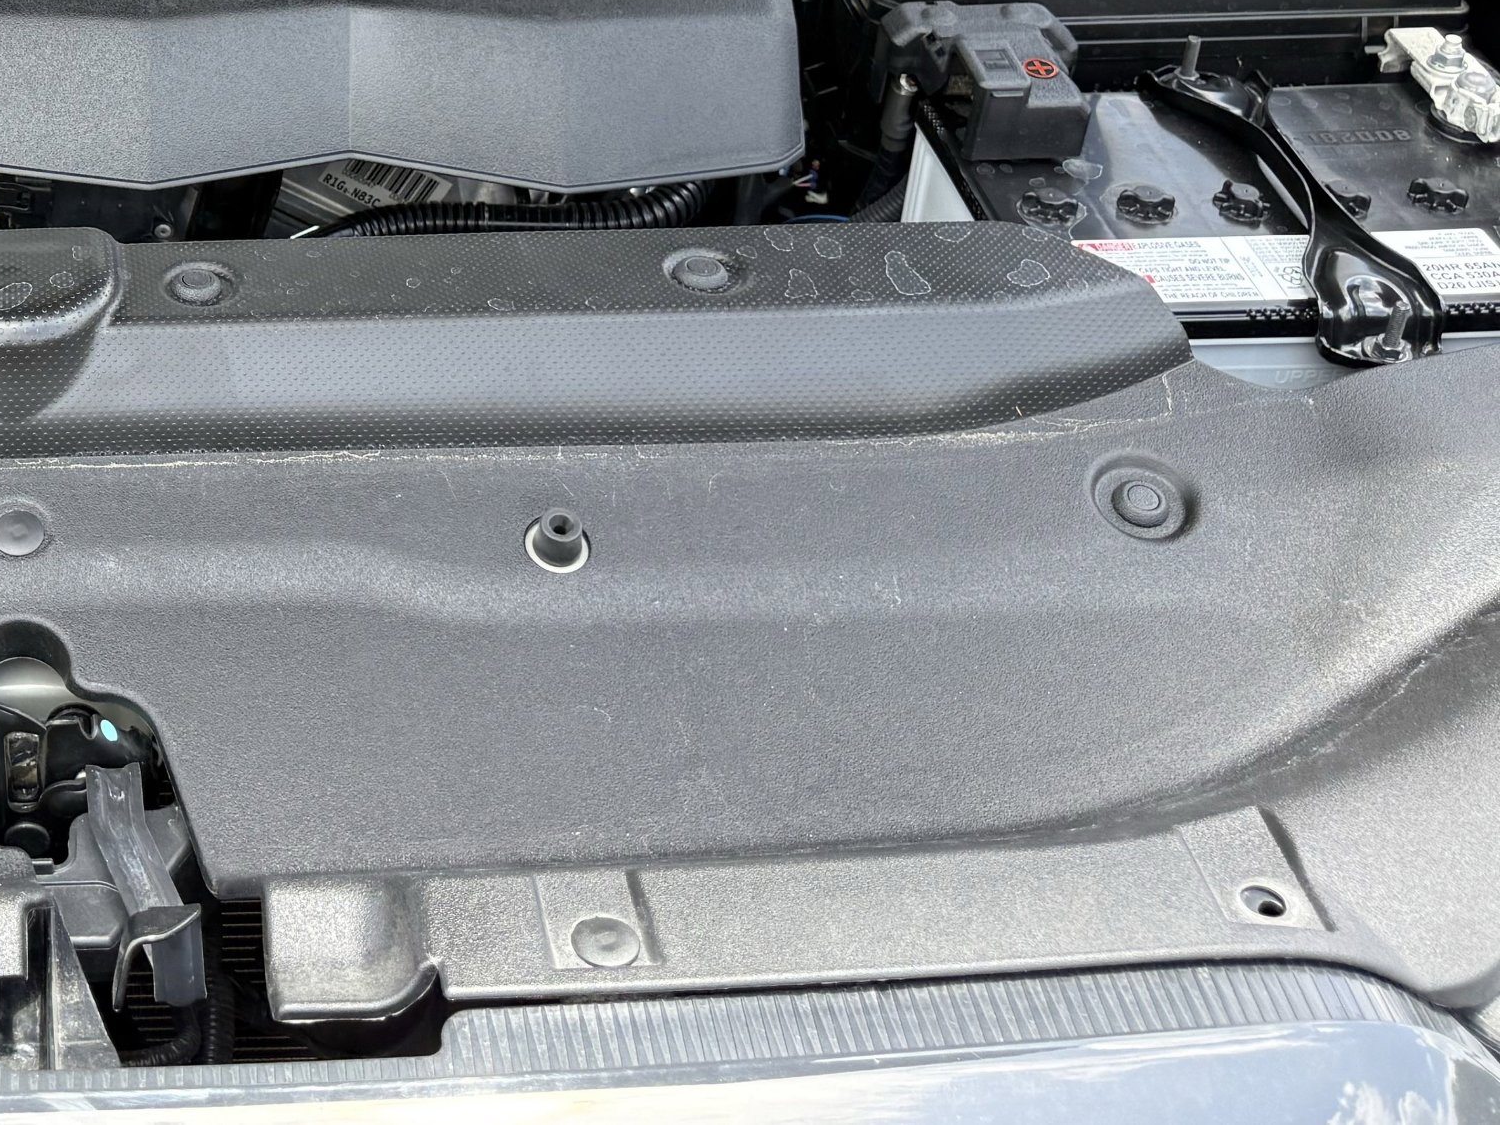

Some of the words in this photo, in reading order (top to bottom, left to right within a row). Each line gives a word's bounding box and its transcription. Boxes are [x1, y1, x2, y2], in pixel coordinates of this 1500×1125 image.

[1423, 263, 1462, 271] 20HR
[1430, 272, 1464, 280] CCA
[1466, 271, 1500, 279] 530A
